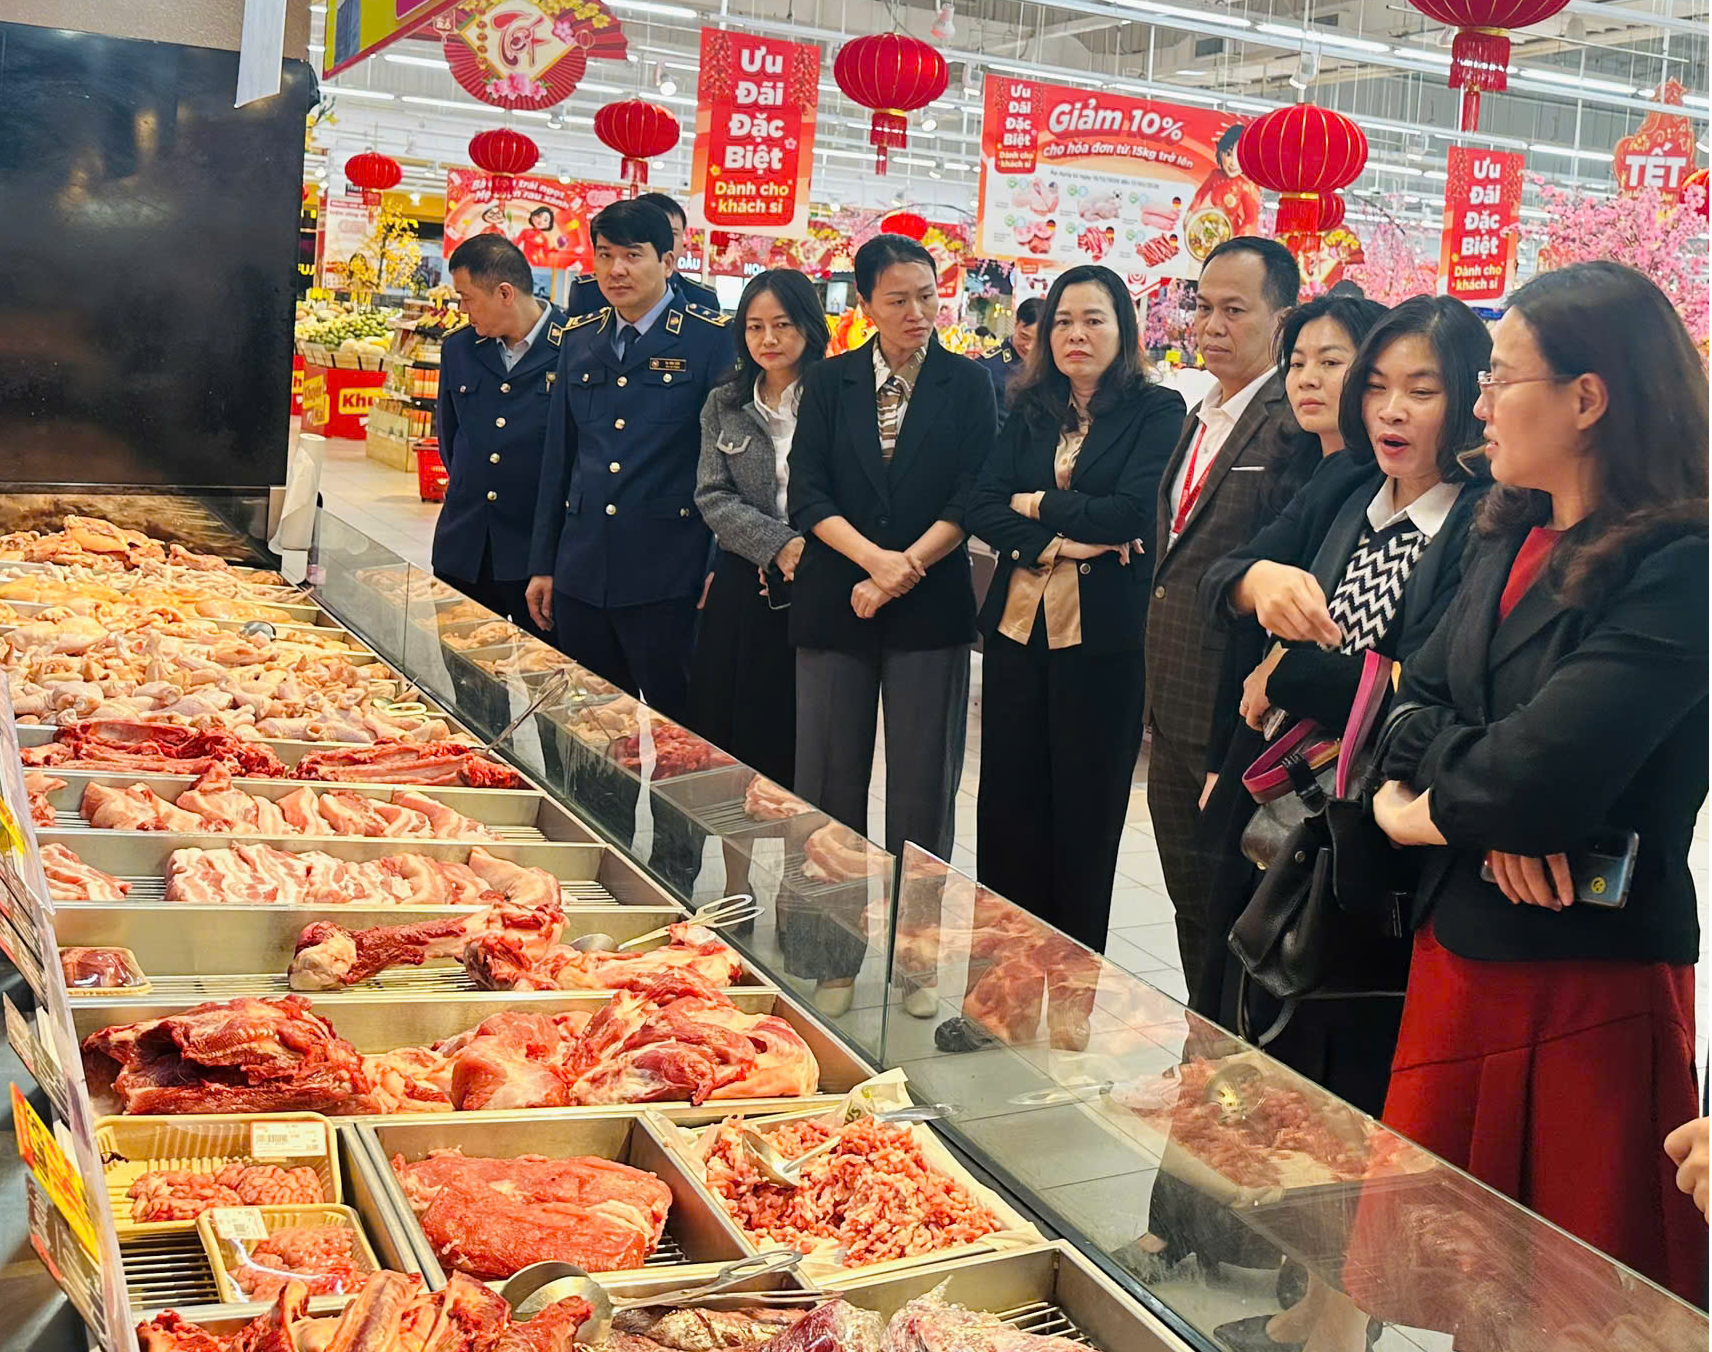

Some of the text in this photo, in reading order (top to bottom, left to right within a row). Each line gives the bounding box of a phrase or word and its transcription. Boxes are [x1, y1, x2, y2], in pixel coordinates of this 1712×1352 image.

[741, 46, 784, 74] Ưu
[735, 81, 784, 106] Đãi
[1010, 83, 1031, 98] Ưu
[728, 113, 784, 143] Đặc
[1005, 117, 1032, 133] Đặc
[1048, 98, 1184, 140] Giảm 10%
[724, 145, 783, 175] Biệt
[1042, 141, 1194, 169] cho hóa đơn từ 15kg trở lên
[1625, 141, 1687, 188] TẾT
[1473, 157, 1501, 179] Ưu
[715, 180, 789, 196] Dành cho
[1469, 185, 1501, 205] Đãi
[718, 198, 766, 214] khách
[1464, 210, 1500, 234] Đặc
[1461, 235, 1499, 259] Biệt
[1454, 264, 1502, 277] Dành cho
[1456, 278, 1488, 291] khách
